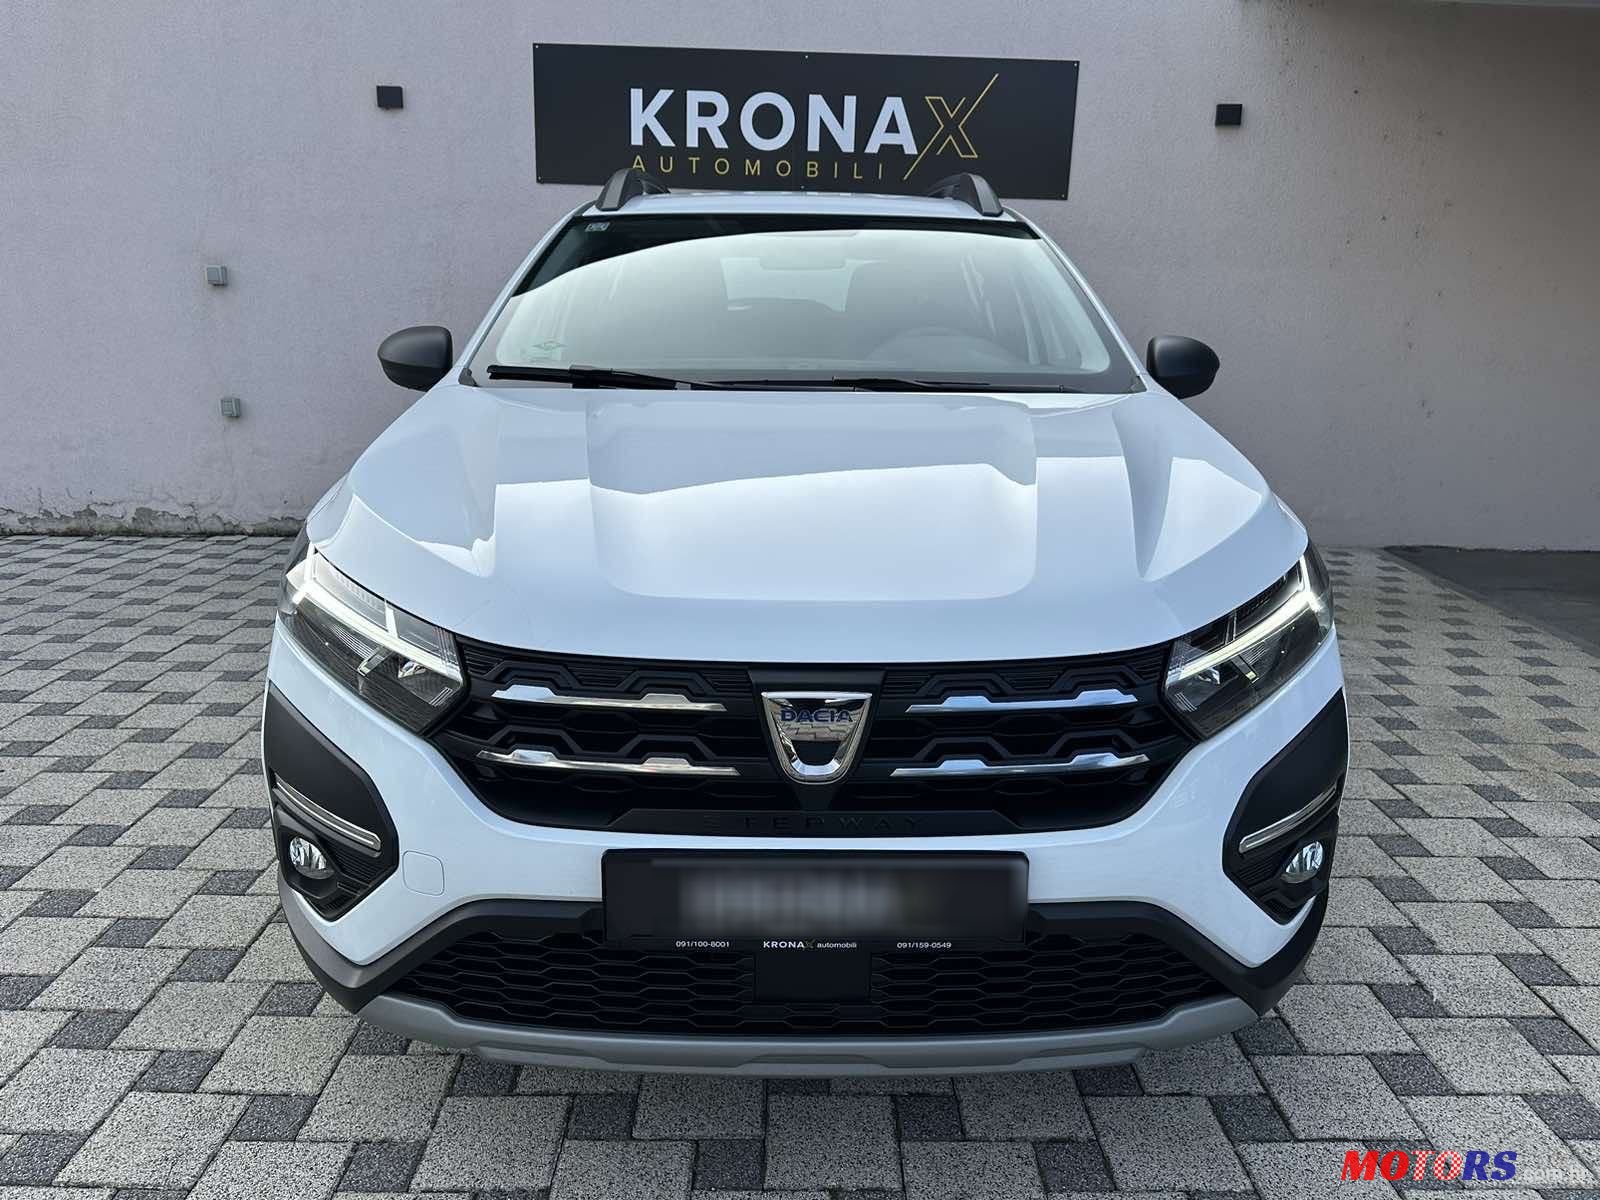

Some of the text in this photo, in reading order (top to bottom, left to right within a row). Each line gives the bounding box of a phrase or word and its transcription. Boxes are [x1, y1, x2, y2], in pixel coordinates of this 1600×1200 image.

[629, 74, 998, 178] KRONAX
[632, 155, 883, 179] AUTOMOBILI
[780, 708, 853, 723] DACIA
[675, 939, 731, 949] 091/100-8001
[816, 941, 858, 949] automobili
[896, 941, 952, 949] 091/159-0549
